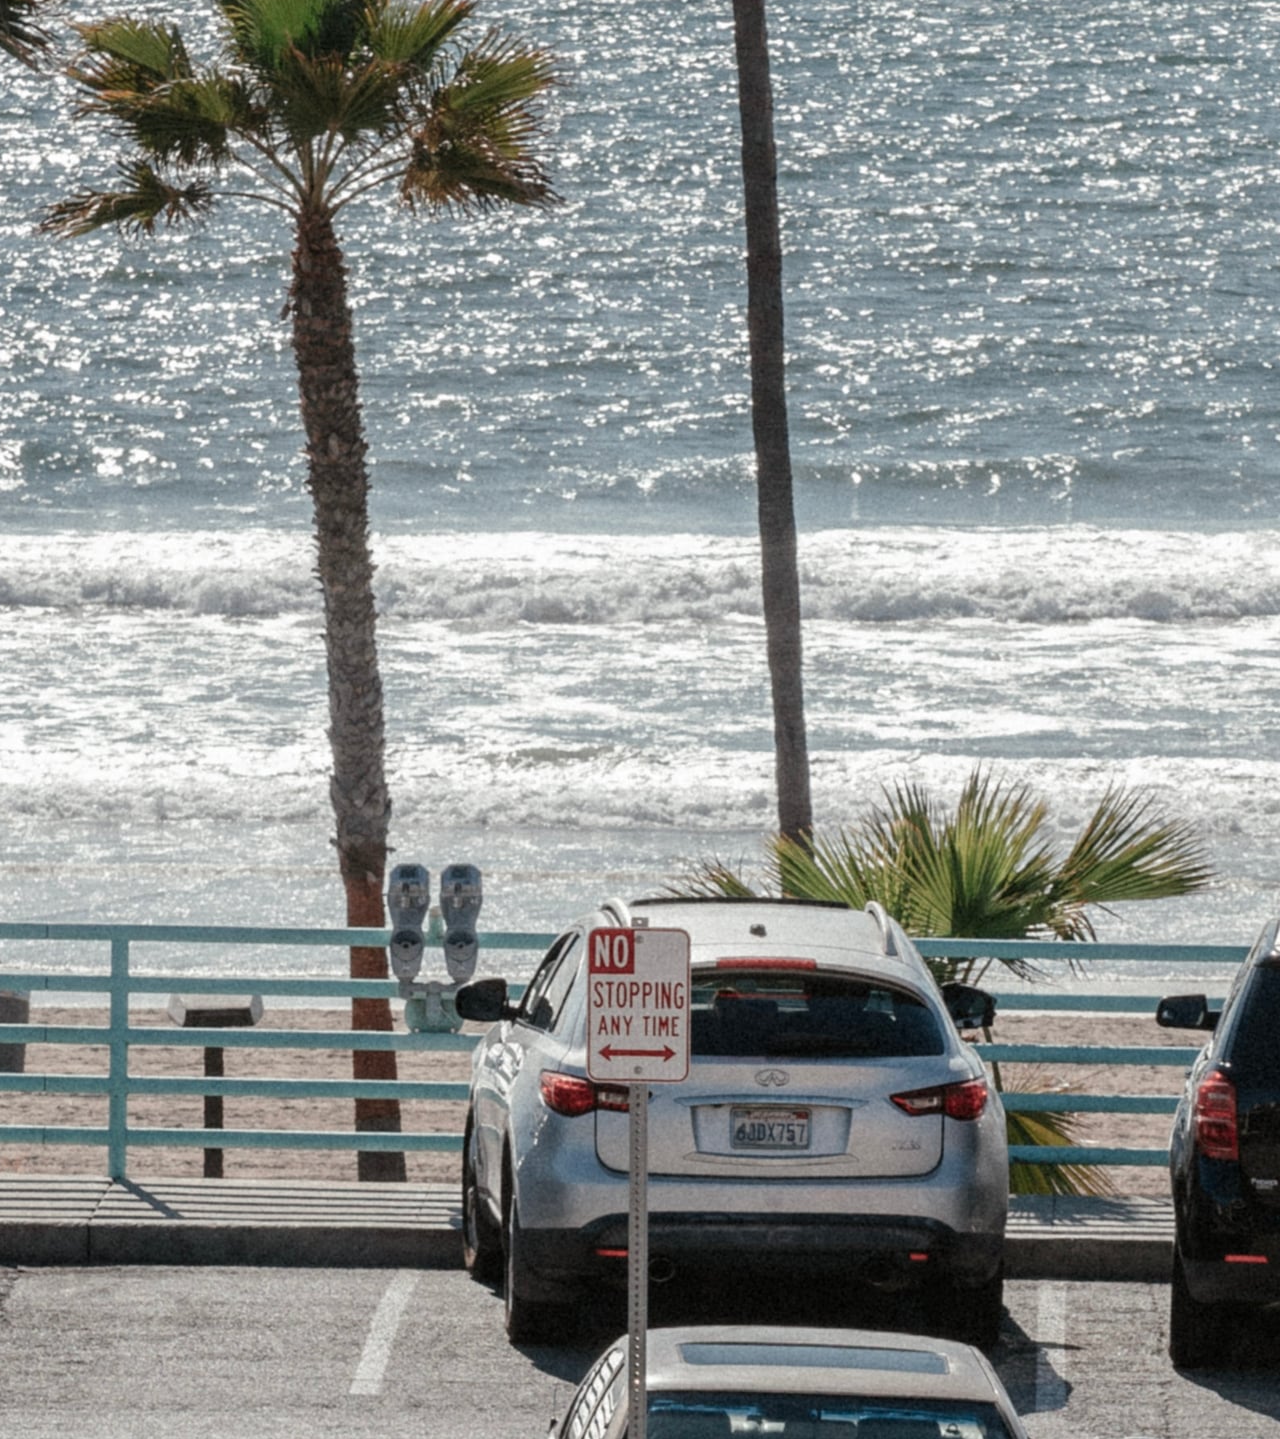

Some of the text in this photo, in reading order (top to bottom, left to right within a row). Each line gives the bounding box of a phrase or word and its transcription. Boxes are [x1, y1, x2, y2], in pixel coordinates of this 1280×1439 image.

[594, 934, 629, 968] NO
[593, 981, 684, 1010] STOPPING
[597, 1015, 680, 1037] ANY TIME
